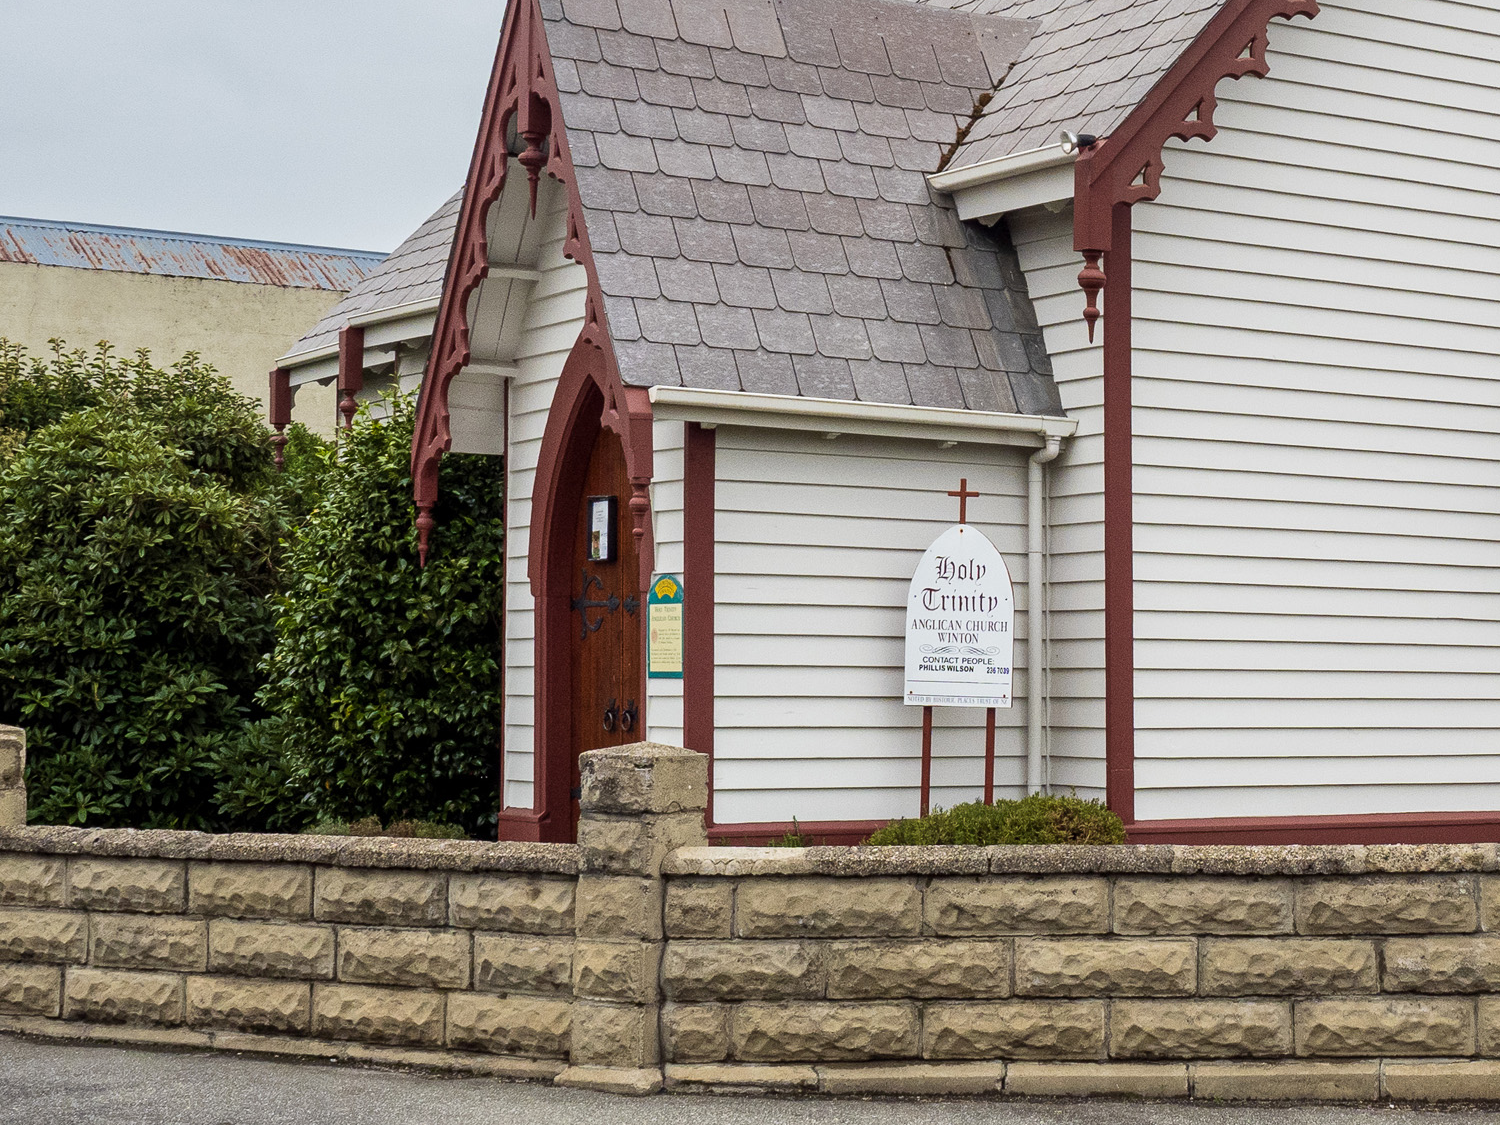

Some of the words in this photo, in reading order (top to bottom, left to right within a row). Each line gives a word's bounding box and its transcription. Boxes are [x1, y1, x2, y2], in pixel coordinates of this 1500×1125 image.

[935, 556, 986, 586] Holy
[921, 588, 998, 618] Trinity
[911, 619, 962, 631] ANGLICAN
[966, 620, 1008, 632] CHURCH
[938, 633, 978, 644] WINTON
[922, 656, 959, 664] CONTACT
[962, 657, 994, 665] PEOPLE:
